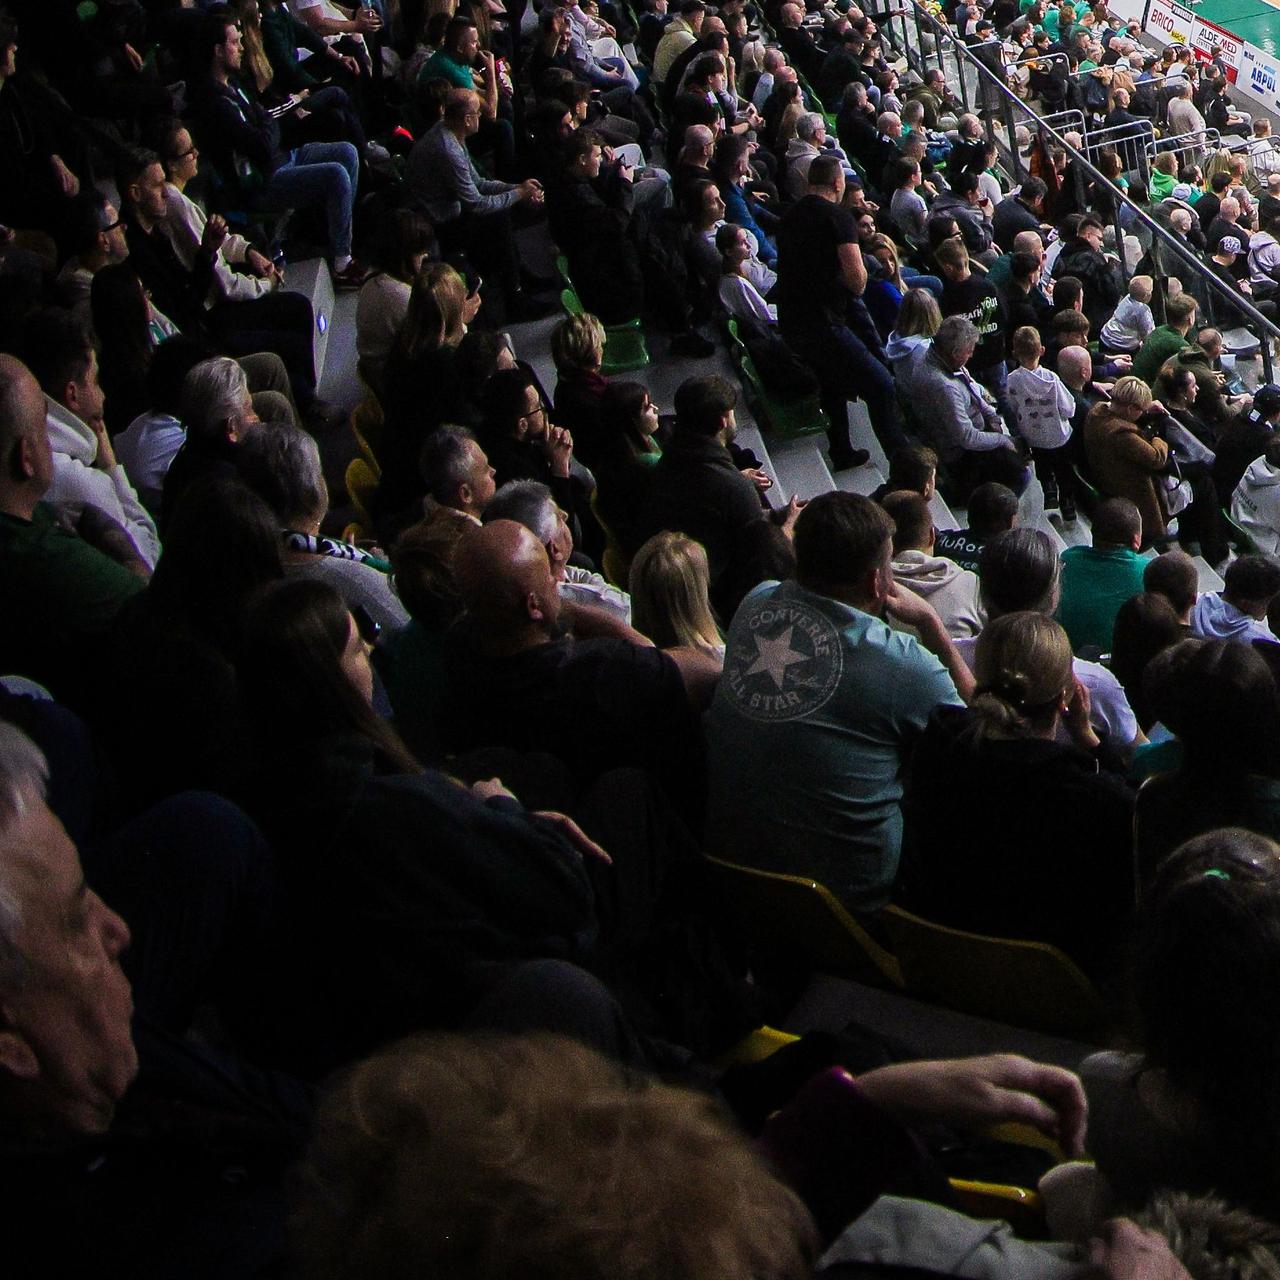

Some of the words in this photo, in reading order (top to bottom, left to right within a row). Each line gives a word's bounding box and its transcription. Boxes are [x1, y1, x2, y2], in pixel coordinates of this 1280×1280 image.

[1150, 8, 1175, 33] BRICO
[1199, 27, 1220, 45] ALDE
[1219, 39, 1237, 55] MED
[1250, 66, 1277, 93] ARPOL
[750, 608, 830, 657] CONVERSE
[750, 691, 801, 711] STAR
